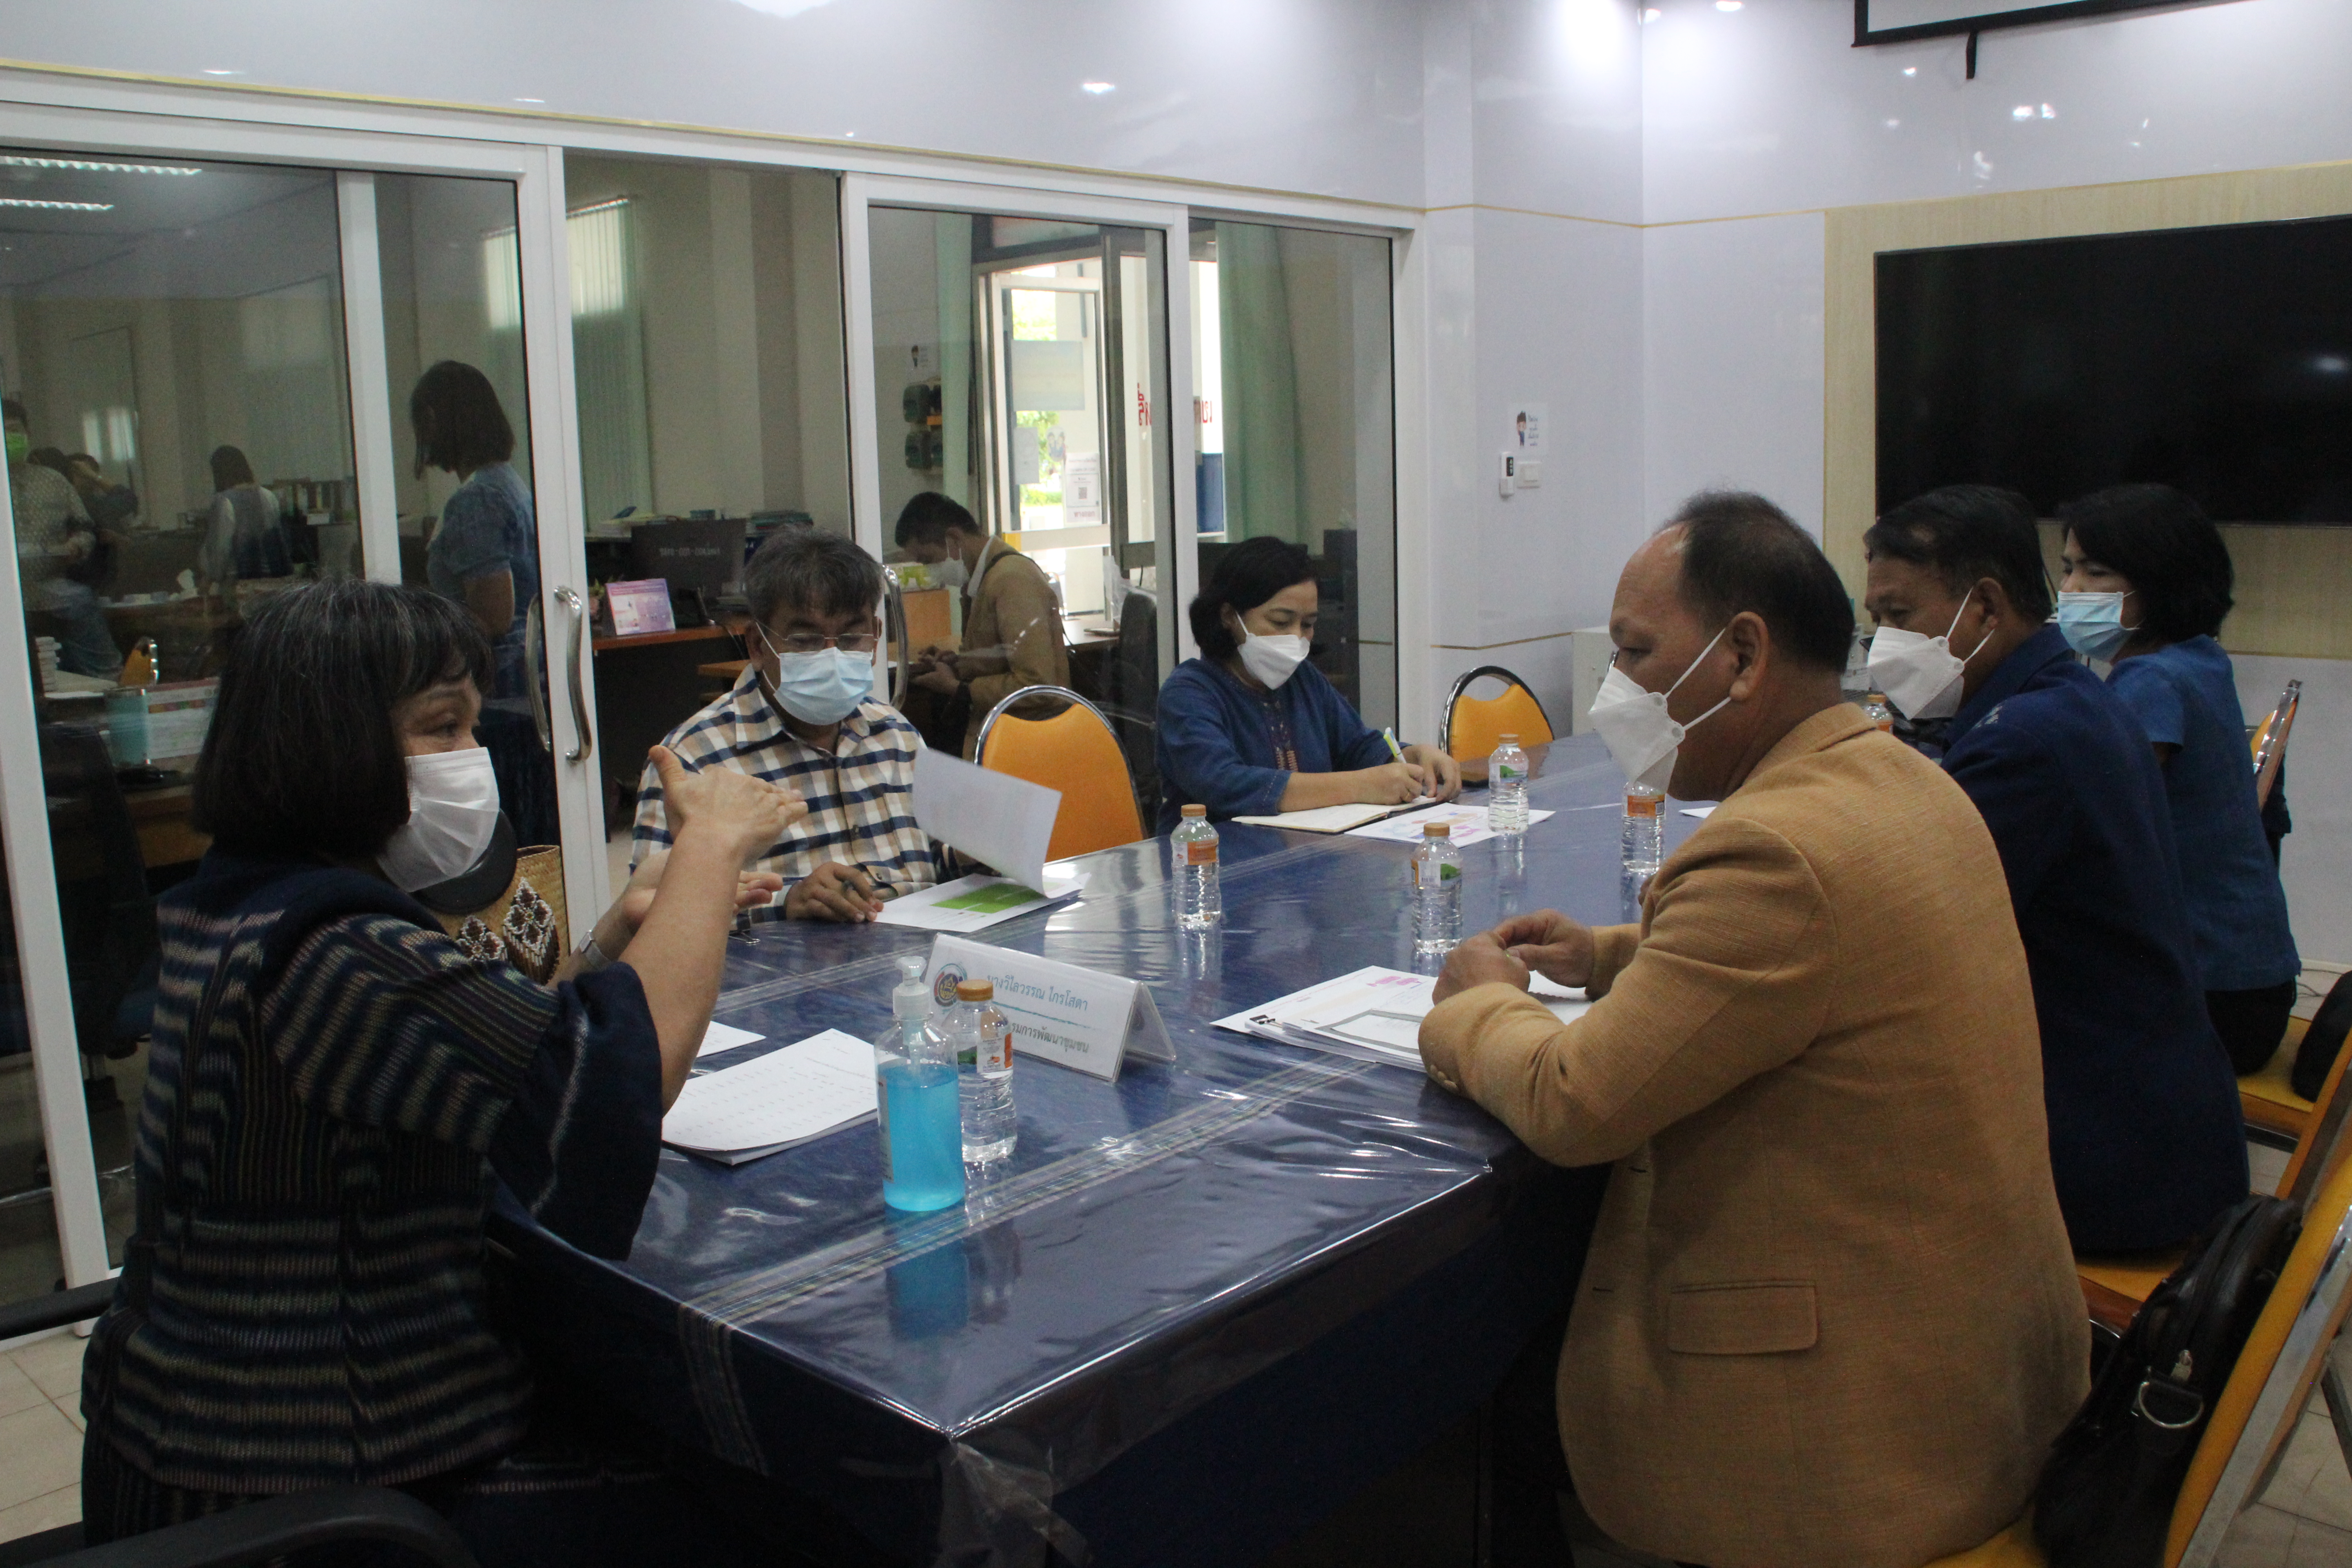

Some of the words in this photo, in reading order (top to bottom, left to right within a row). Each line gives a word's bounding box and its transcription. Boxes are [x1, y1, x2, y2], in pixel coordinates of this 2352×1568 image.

[1011, 1023, 1090, 1053] รมการพัฒนาชุมชน
